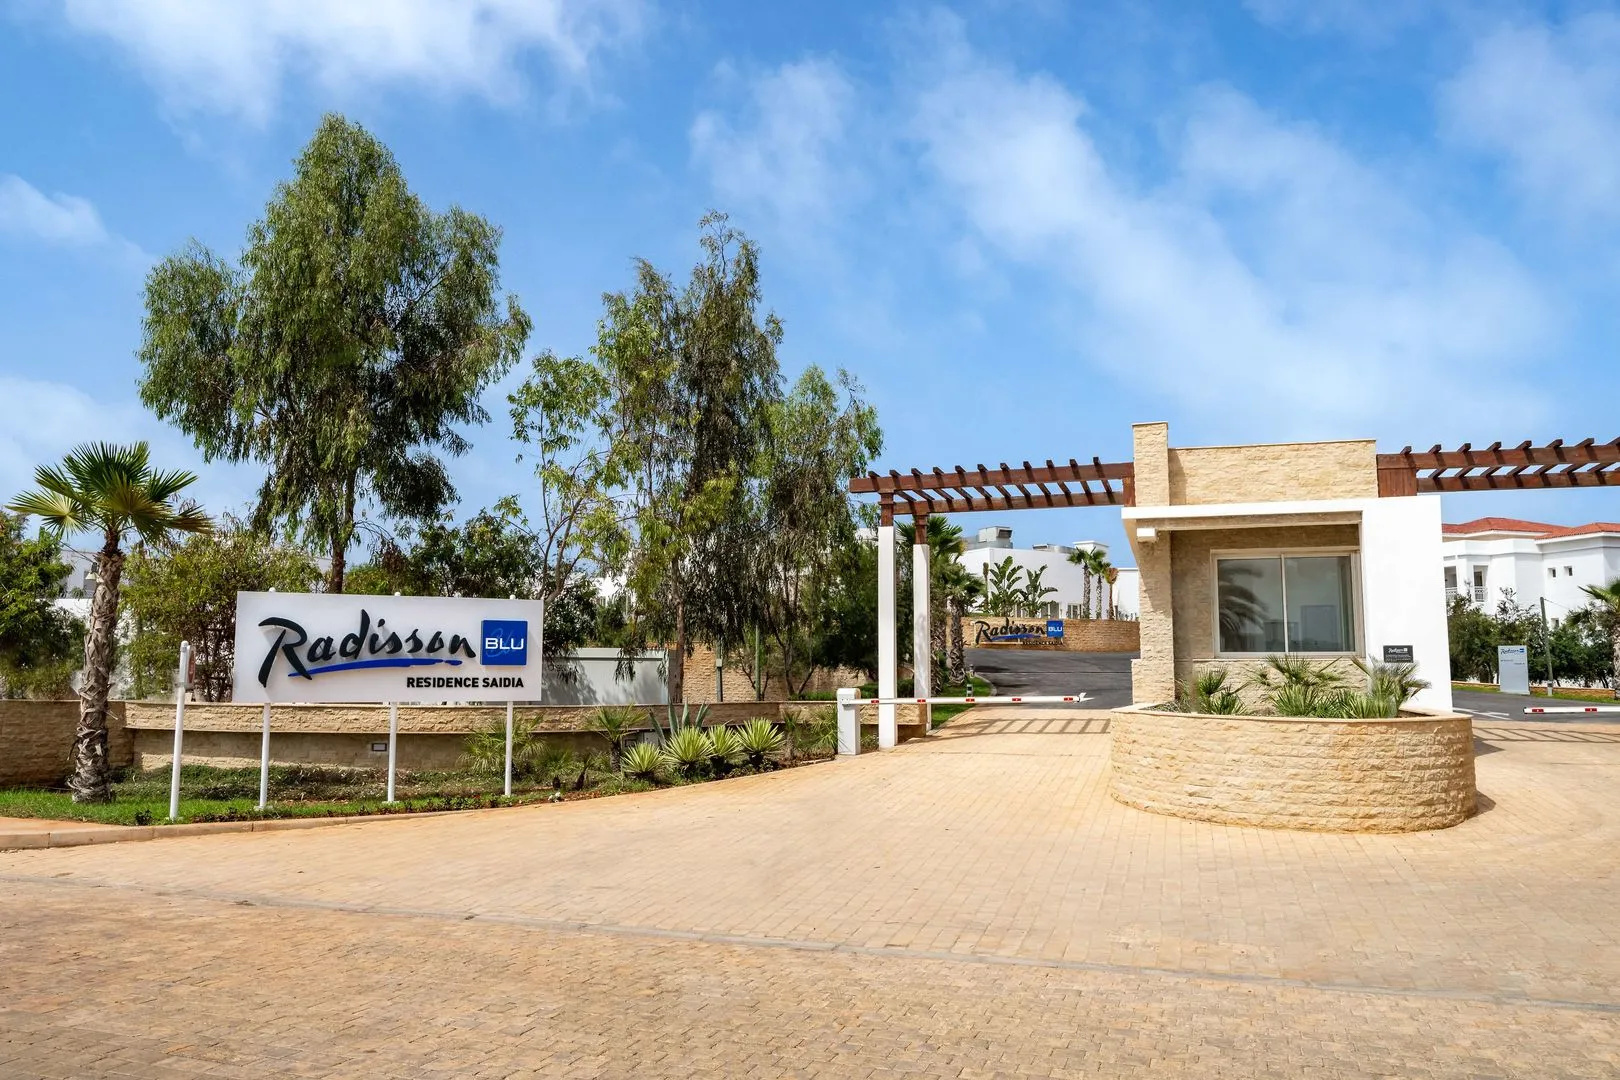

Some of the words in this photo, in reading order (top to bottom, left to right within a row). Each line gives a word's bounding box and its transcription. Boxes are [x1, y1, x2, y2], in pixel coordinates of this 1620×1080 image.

[258, 609, 476, 688] Radisson
[485, 637, 524, 650] BLU
[406, 677, 479, 688] RESIDENCE
[482, 677, 524, 688] SAIDIA
